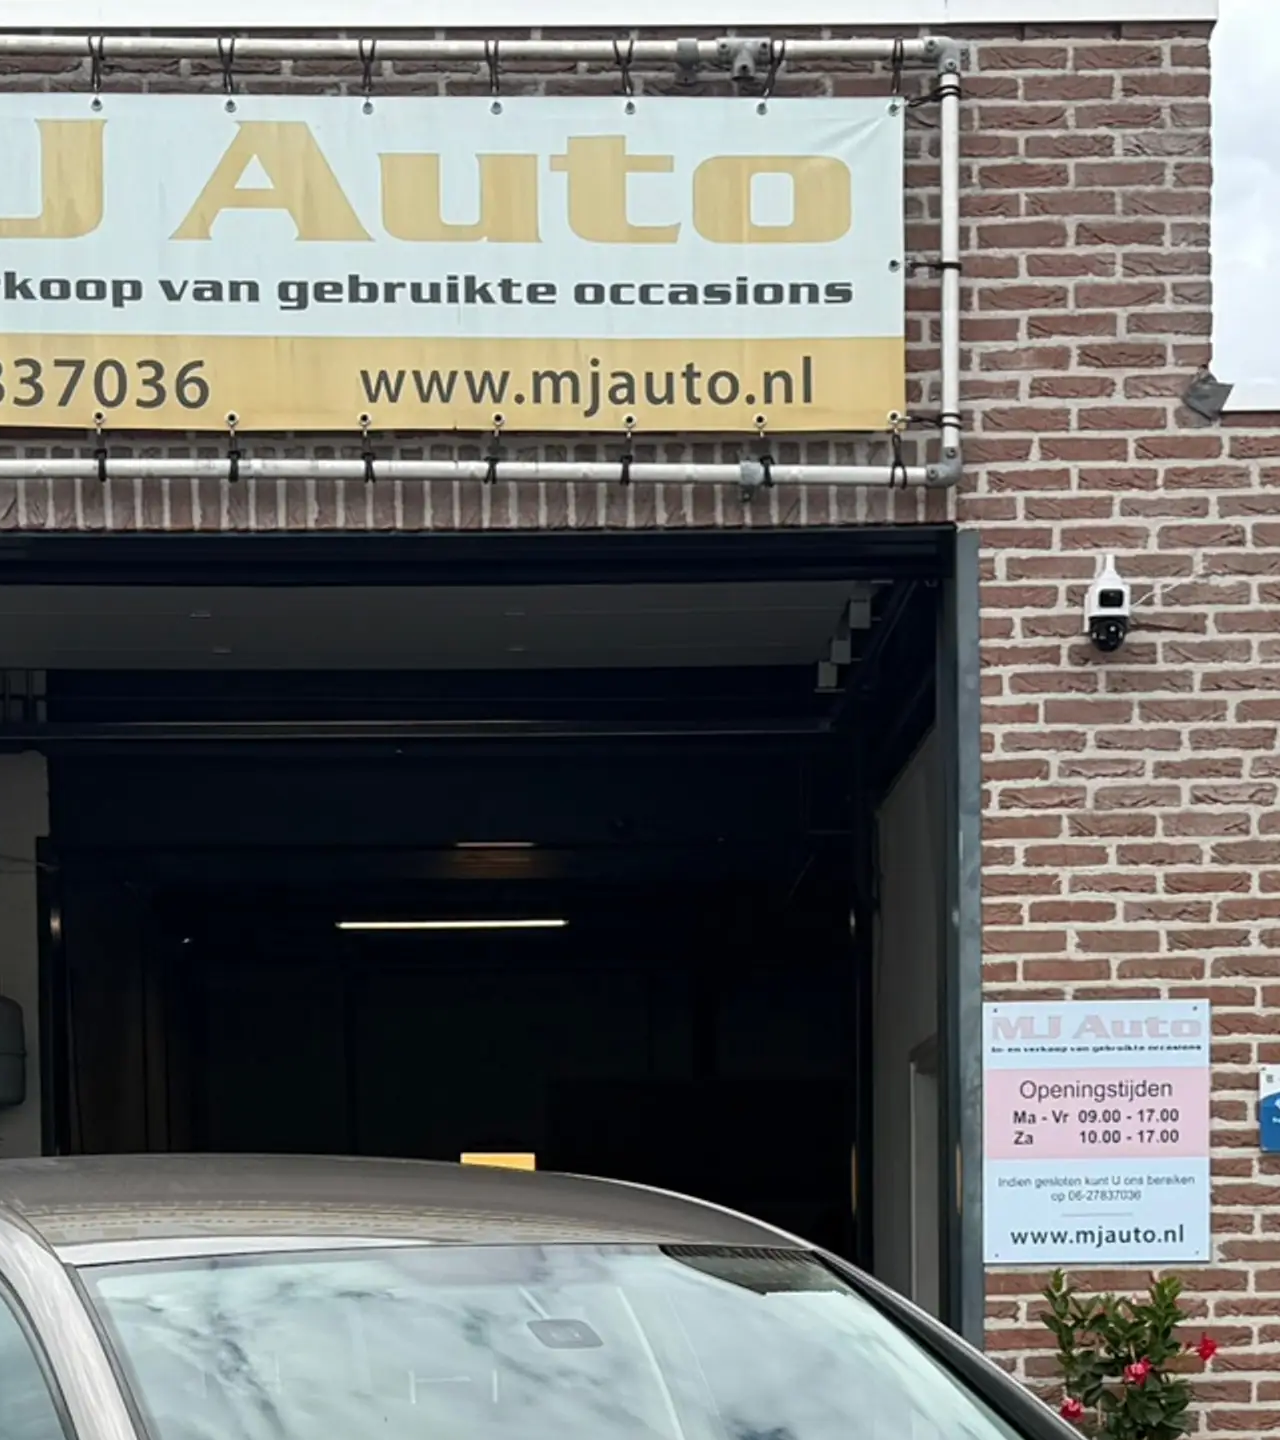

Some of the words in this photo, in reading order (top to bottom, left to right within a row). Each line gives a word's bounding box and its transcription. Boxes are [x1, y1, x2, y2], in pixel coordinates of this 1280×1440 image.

[169, 120, 852, 244] Auto
[158, 278, 260, 303] van
[277, 274, 558, 311] gebruikte
[573, 276, 854, 305] occasions
[360, 356, 813, 417] www.mjauto.nl
[991, 1016, 1062, 1040] MJ
[1072, 1014, 1202, 1040] Auto
[1019, 1080, 1173, 1103] Openingstijden
[1013, 1110, 1037, 1124] Ma
[1051, 1110, 1069, 1124] Vr
[1078, 1109, 1121, 1123] 09.00
[1137, 1108, 1179, 1123] 17.00
[1013, 1131, 1034, 1145] Za
[1079, 1130, 1121, 1144] 10.00
[1137, 1129, 1179, 1143] 17.00
[998, 1176, 1031, 1187] Indien
[1034, 1175, 1082, 1189] gesloten
[1084, 1175, 1110, 1186] kunt
[1112, 1175, 1121, 1186] U
[1123, 1177, 1144, 1186] ons
[1147, 1174, 1196, 1186] bereiken
[1051, 1191, 1066, 1202] op
[1010, 1224, 1185, 1248] www.mjauto.nl
